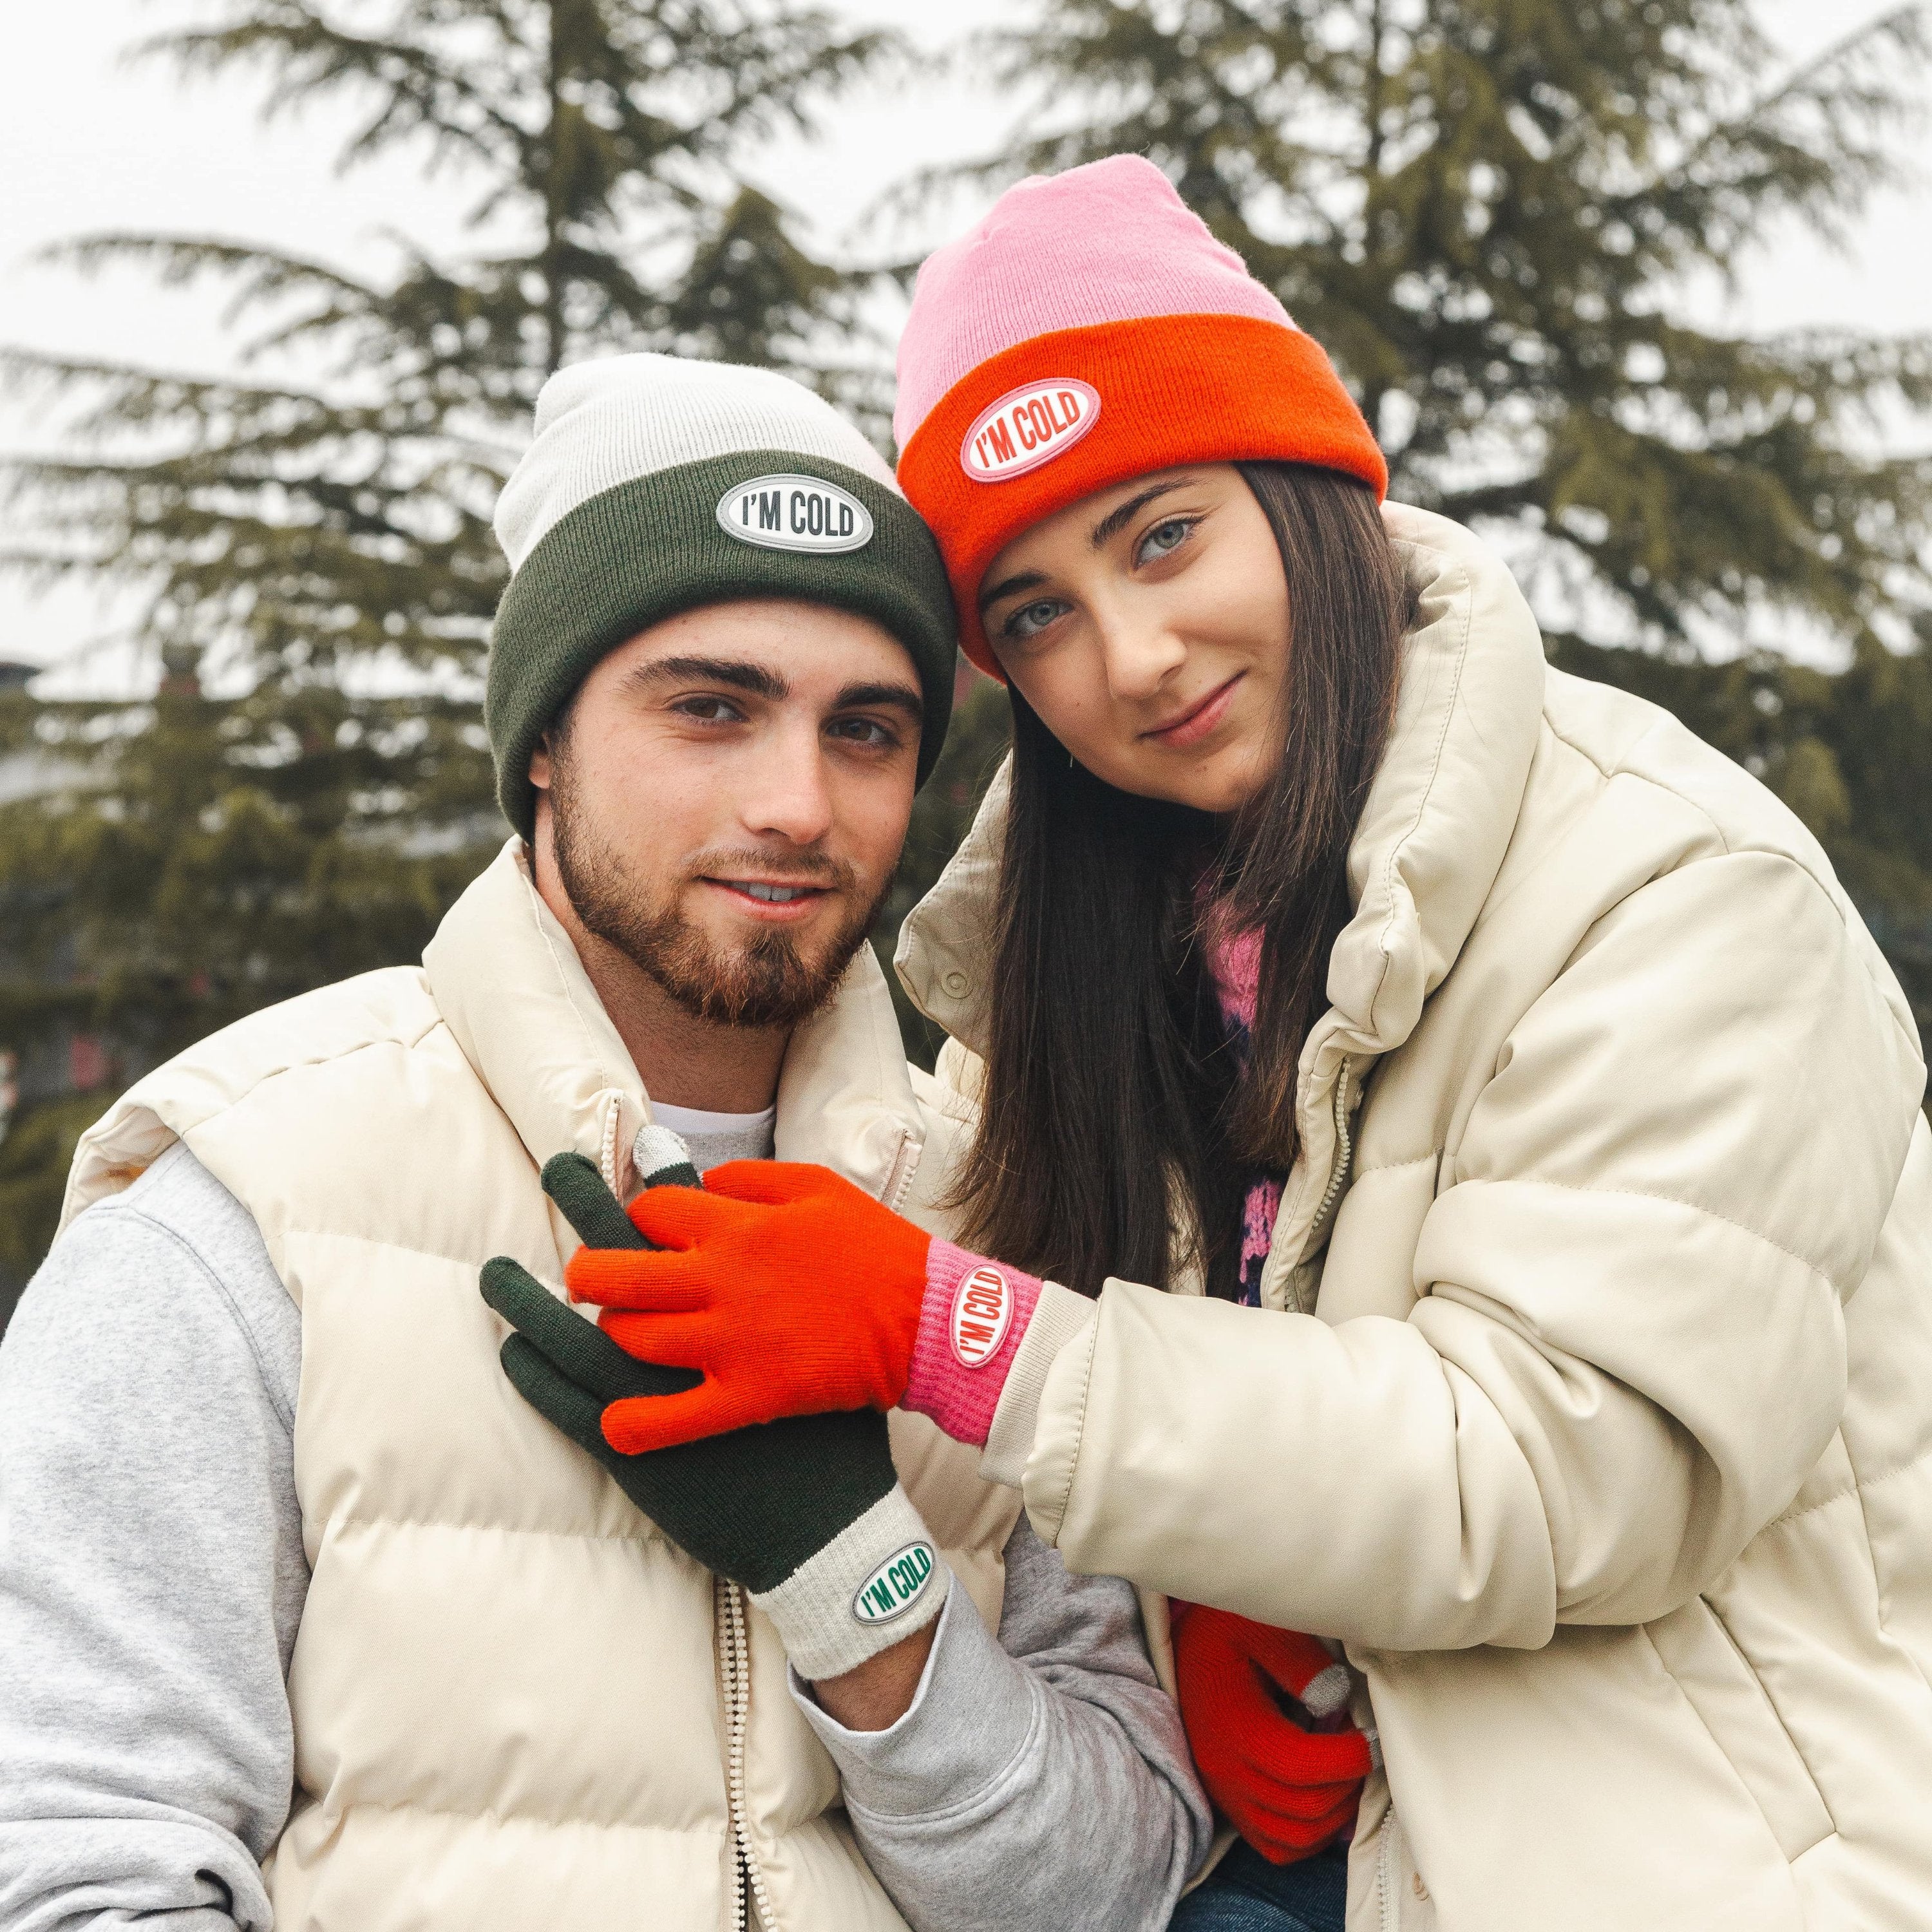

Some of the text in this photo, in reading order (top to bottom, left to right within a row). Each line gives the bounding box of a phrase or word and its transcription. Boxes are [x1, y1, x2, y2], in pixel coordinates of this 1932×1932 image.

[975, 391, 1081, 468] I'M COLD
[743, 490, 854, 536] I'M COLD
[960, 1271, 1003, 1355] I'M COLD
[860, 1548, 931, 1617] I'M COLD
